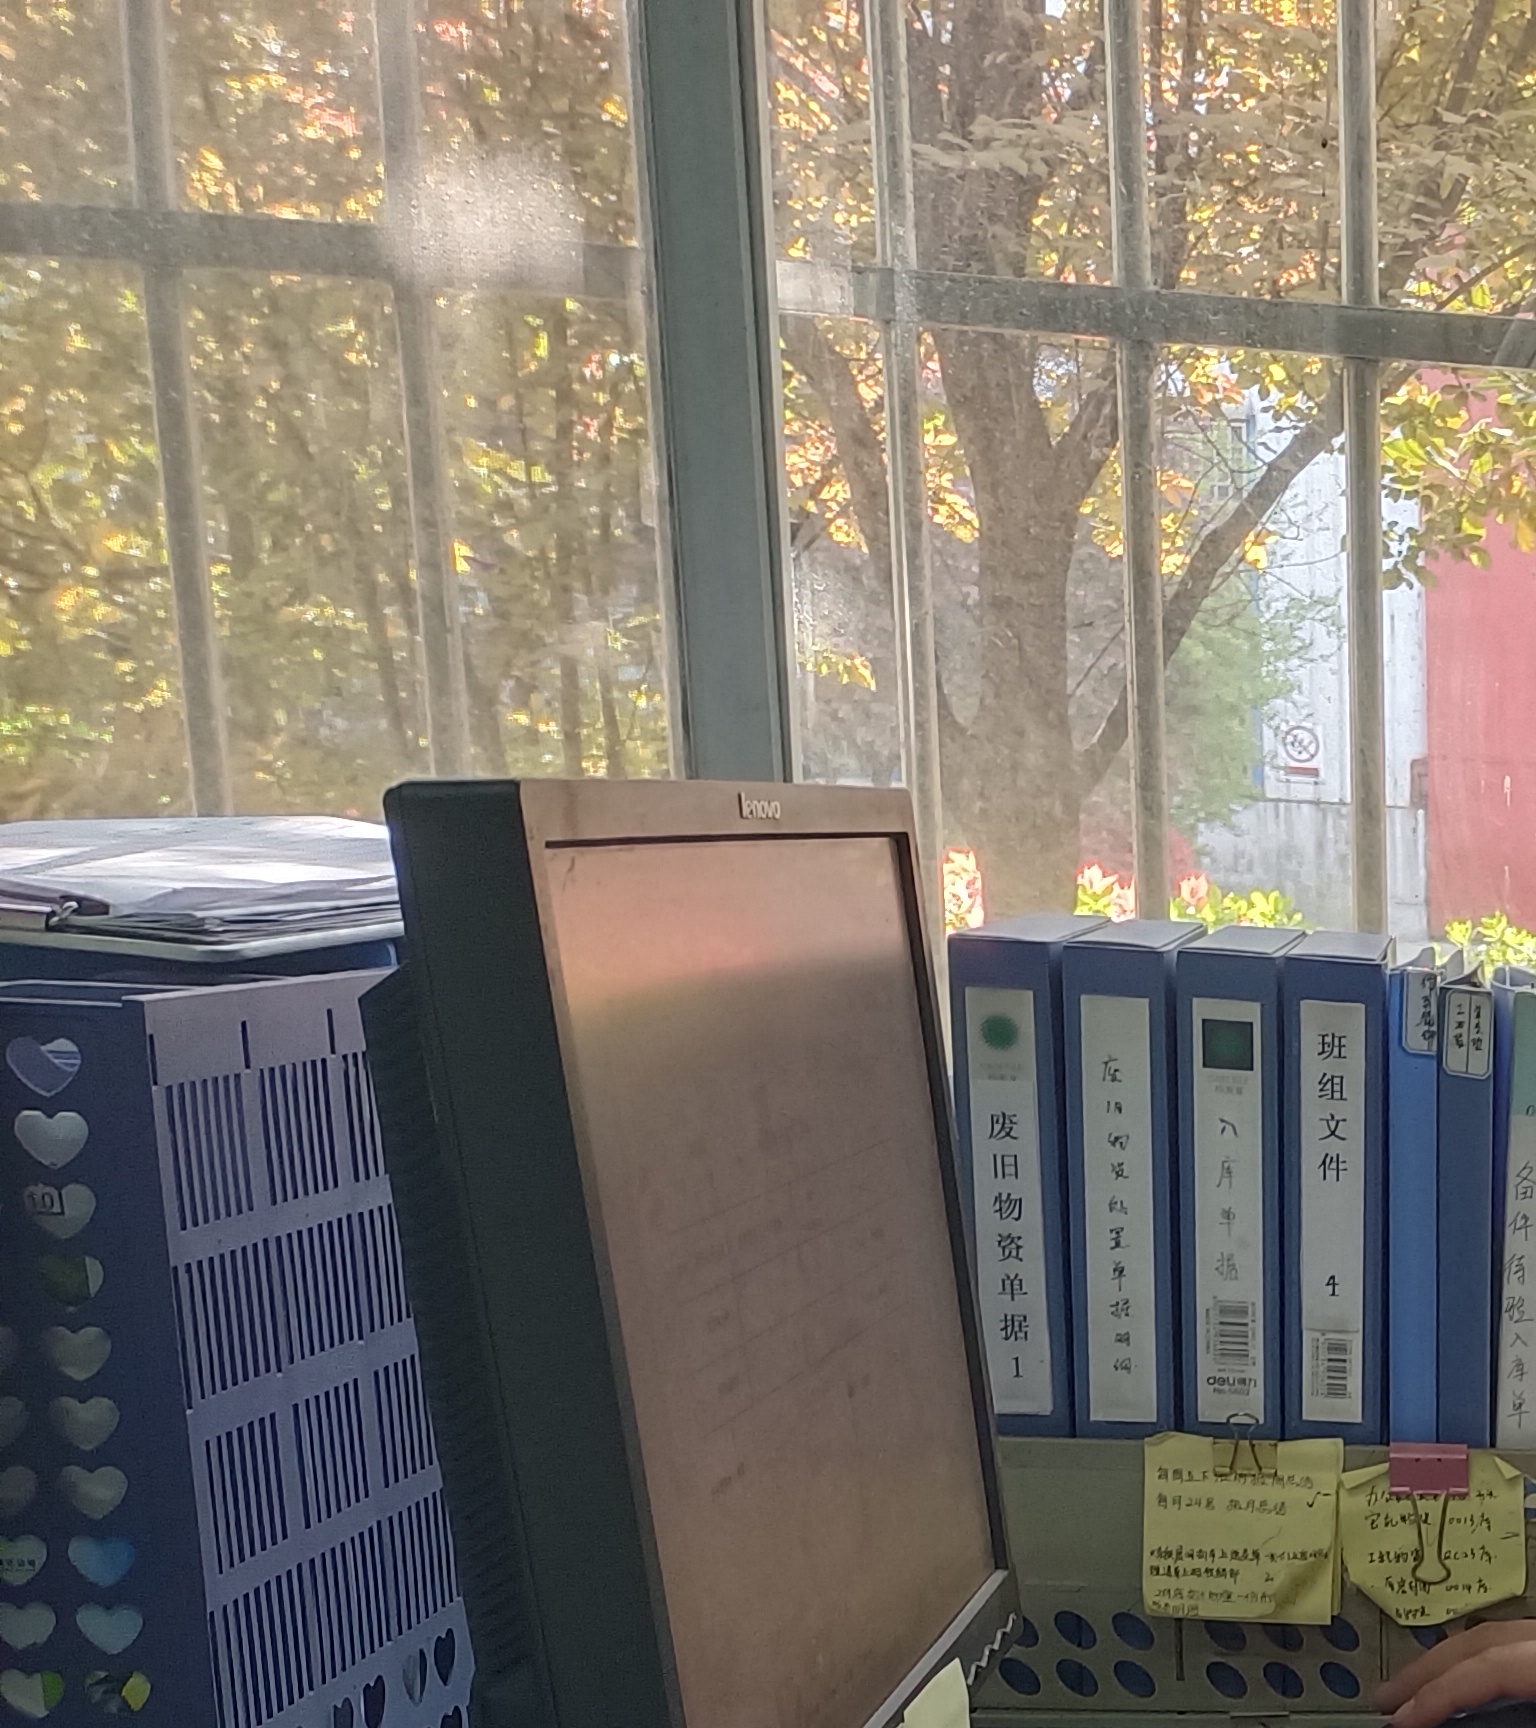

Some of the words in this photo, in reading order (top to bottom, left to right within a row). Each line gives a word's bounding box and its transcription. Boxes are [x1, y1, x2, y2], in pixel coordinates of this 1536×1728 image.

[739, 793, 781, 820] lenovo
[1317, 1033, 1348, 1182] 班组文件
[1215, 1117, 1240, 1281] 入库单据
[1325, 1275, 1338, 1296] 4
